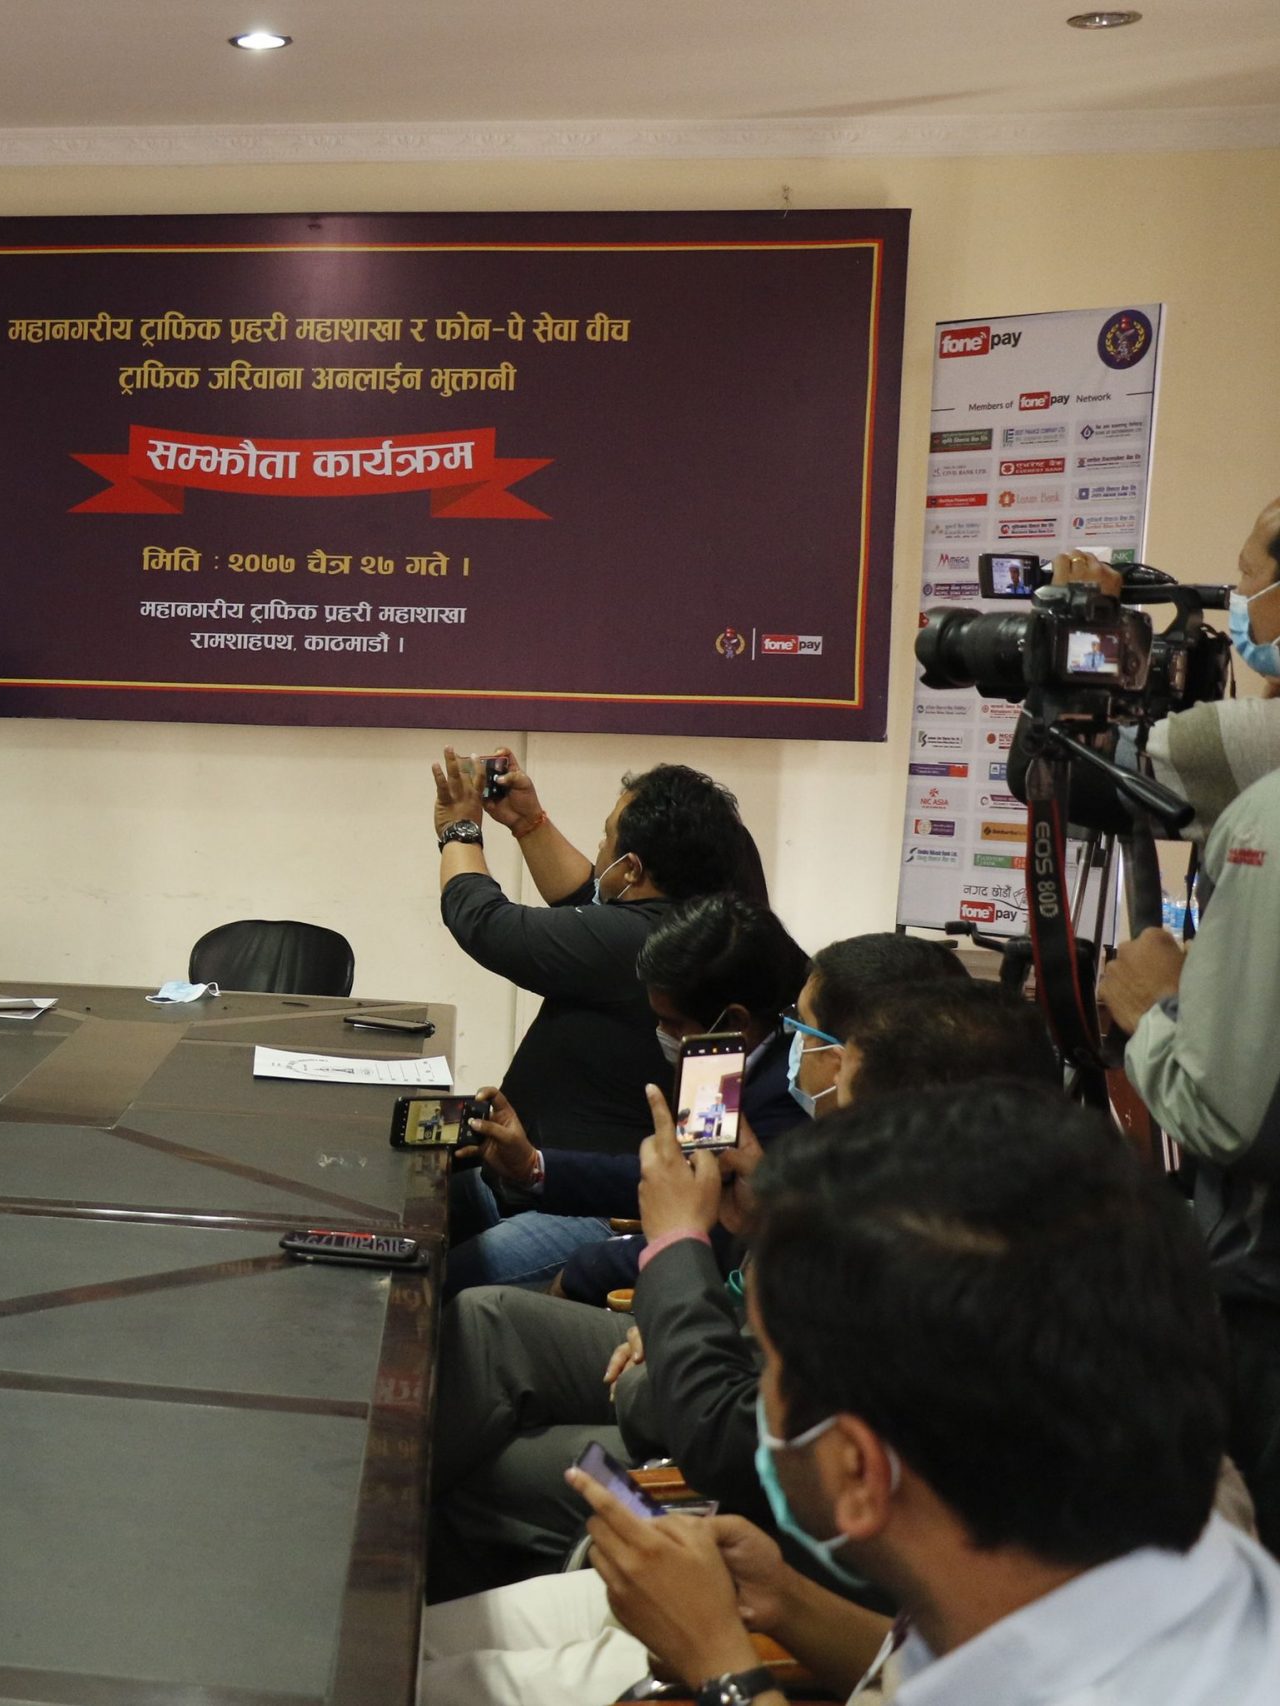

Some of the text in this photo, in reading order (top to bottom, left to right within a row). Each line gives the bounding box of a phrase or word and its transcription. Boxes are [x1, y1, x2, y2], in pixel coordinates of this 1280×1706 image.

[8, 311, 133, 343] महानगरीय
[140, 310, 222, 347] ट्राफिक
[230, 311, 288, 344] प्रहरी
[295, 318, 402, 343] महाशाखा
[410, 318, 428, 342] र
[532, 311, 579, 343] सेवा
[118, 359, 517, 398] ट्राफिक जरिवाना अनलाईन भुक्तानी
[969, 402, 1003, 411] Members
[1006, 400, 1013, 409] of
[1076, 392, 1111, 403] Network
[147, 439, 475, 480] सम्झौता कार्यक्रम
[142, 546, 202, 572] मिति
[227, 553, 296, 575] २०७७
[306, 549, 352, 575] चैत्र
[360, 555, 394, 575] २७
[405, 551, 450, 577] गते
[140, 598, 467, 626] महानगरीय ट्राफिक प्रहरी महाशाखा
[1035, 821, 1059, 919] EOS 80D
[963, 884, 988, 897] नगद
